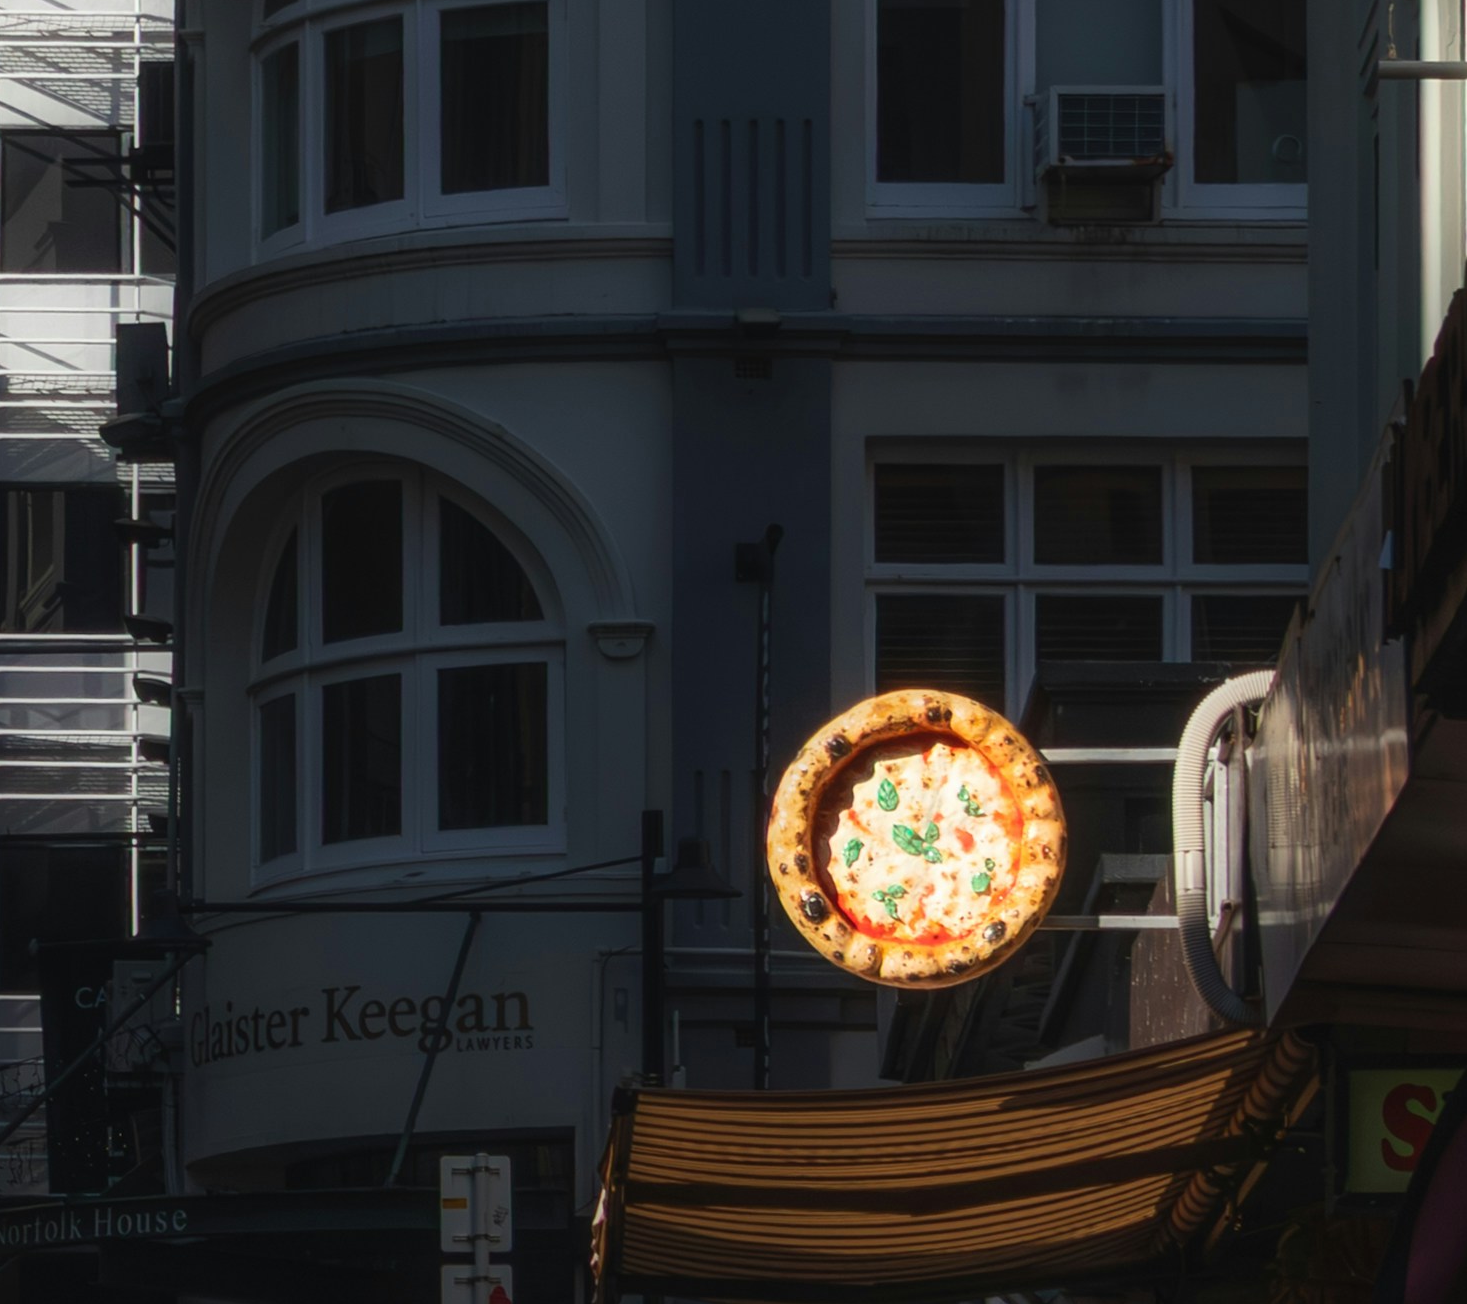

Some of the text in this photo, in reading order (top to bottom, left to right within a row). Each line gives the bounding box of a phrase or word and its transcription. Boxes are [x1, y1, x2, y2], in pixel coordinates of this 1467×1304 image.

[189, 984, 536, 1069] Glaister Keegan
[455, 1034, 535, 1054] LAWYERS
[92, 1206, 189, 1238] House
